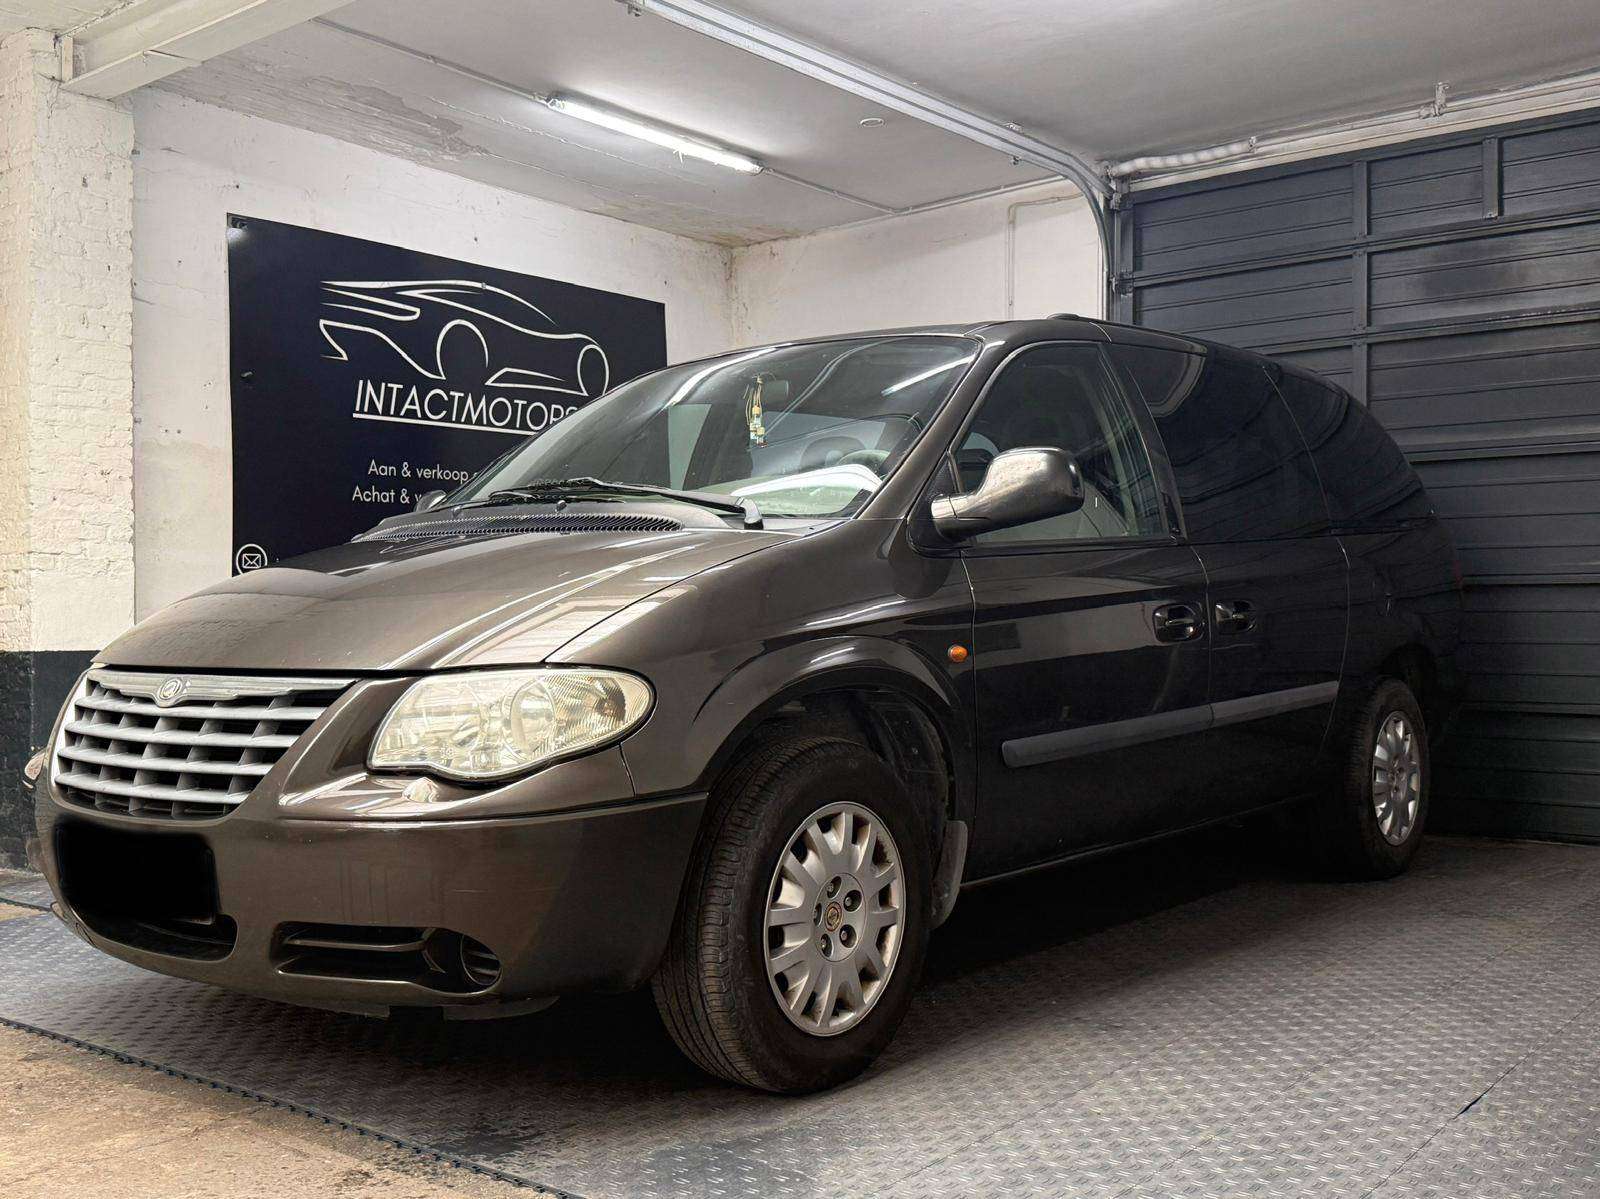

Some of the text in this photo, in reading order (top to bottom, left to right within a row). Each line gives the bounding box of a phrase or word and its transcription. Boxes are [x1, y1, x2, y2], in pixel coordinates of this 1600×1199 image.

[367, 459, 397, 477] Aan
[401, 461, 412, 478] &
[416, 463, 470, 485] verkoop
[352, 485, 396, 503] Achat
[400, 488, 411, 504] &
